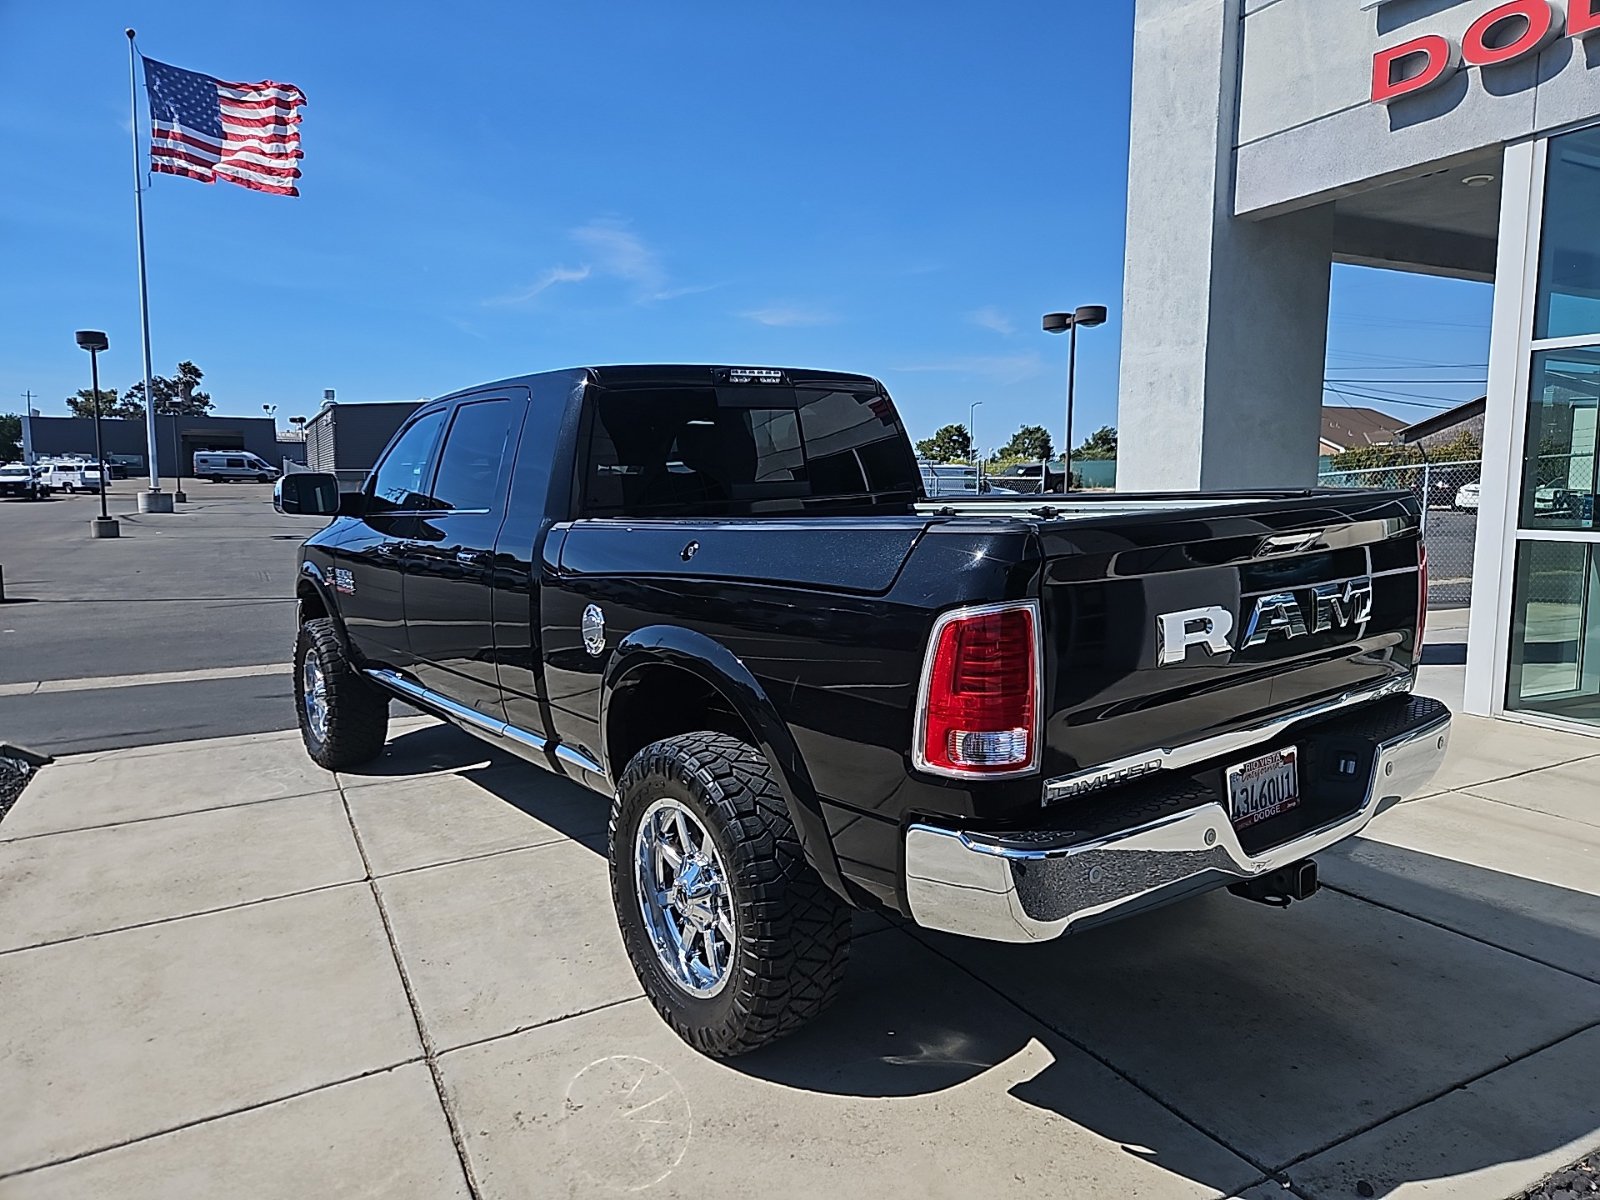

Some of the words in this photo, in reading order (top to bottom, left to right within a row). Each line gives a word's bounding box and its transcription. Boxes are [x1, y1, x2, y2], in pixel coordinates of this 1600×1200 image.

[1157, 576, 1371, 668] RAM
[1245, 760, 1259, 772] RIO
[1260, 753, 1281, 767] VISTA
[1047, 758, 1162, 800] LIMITED
[1253, 804, 1281, 822] DODGE
